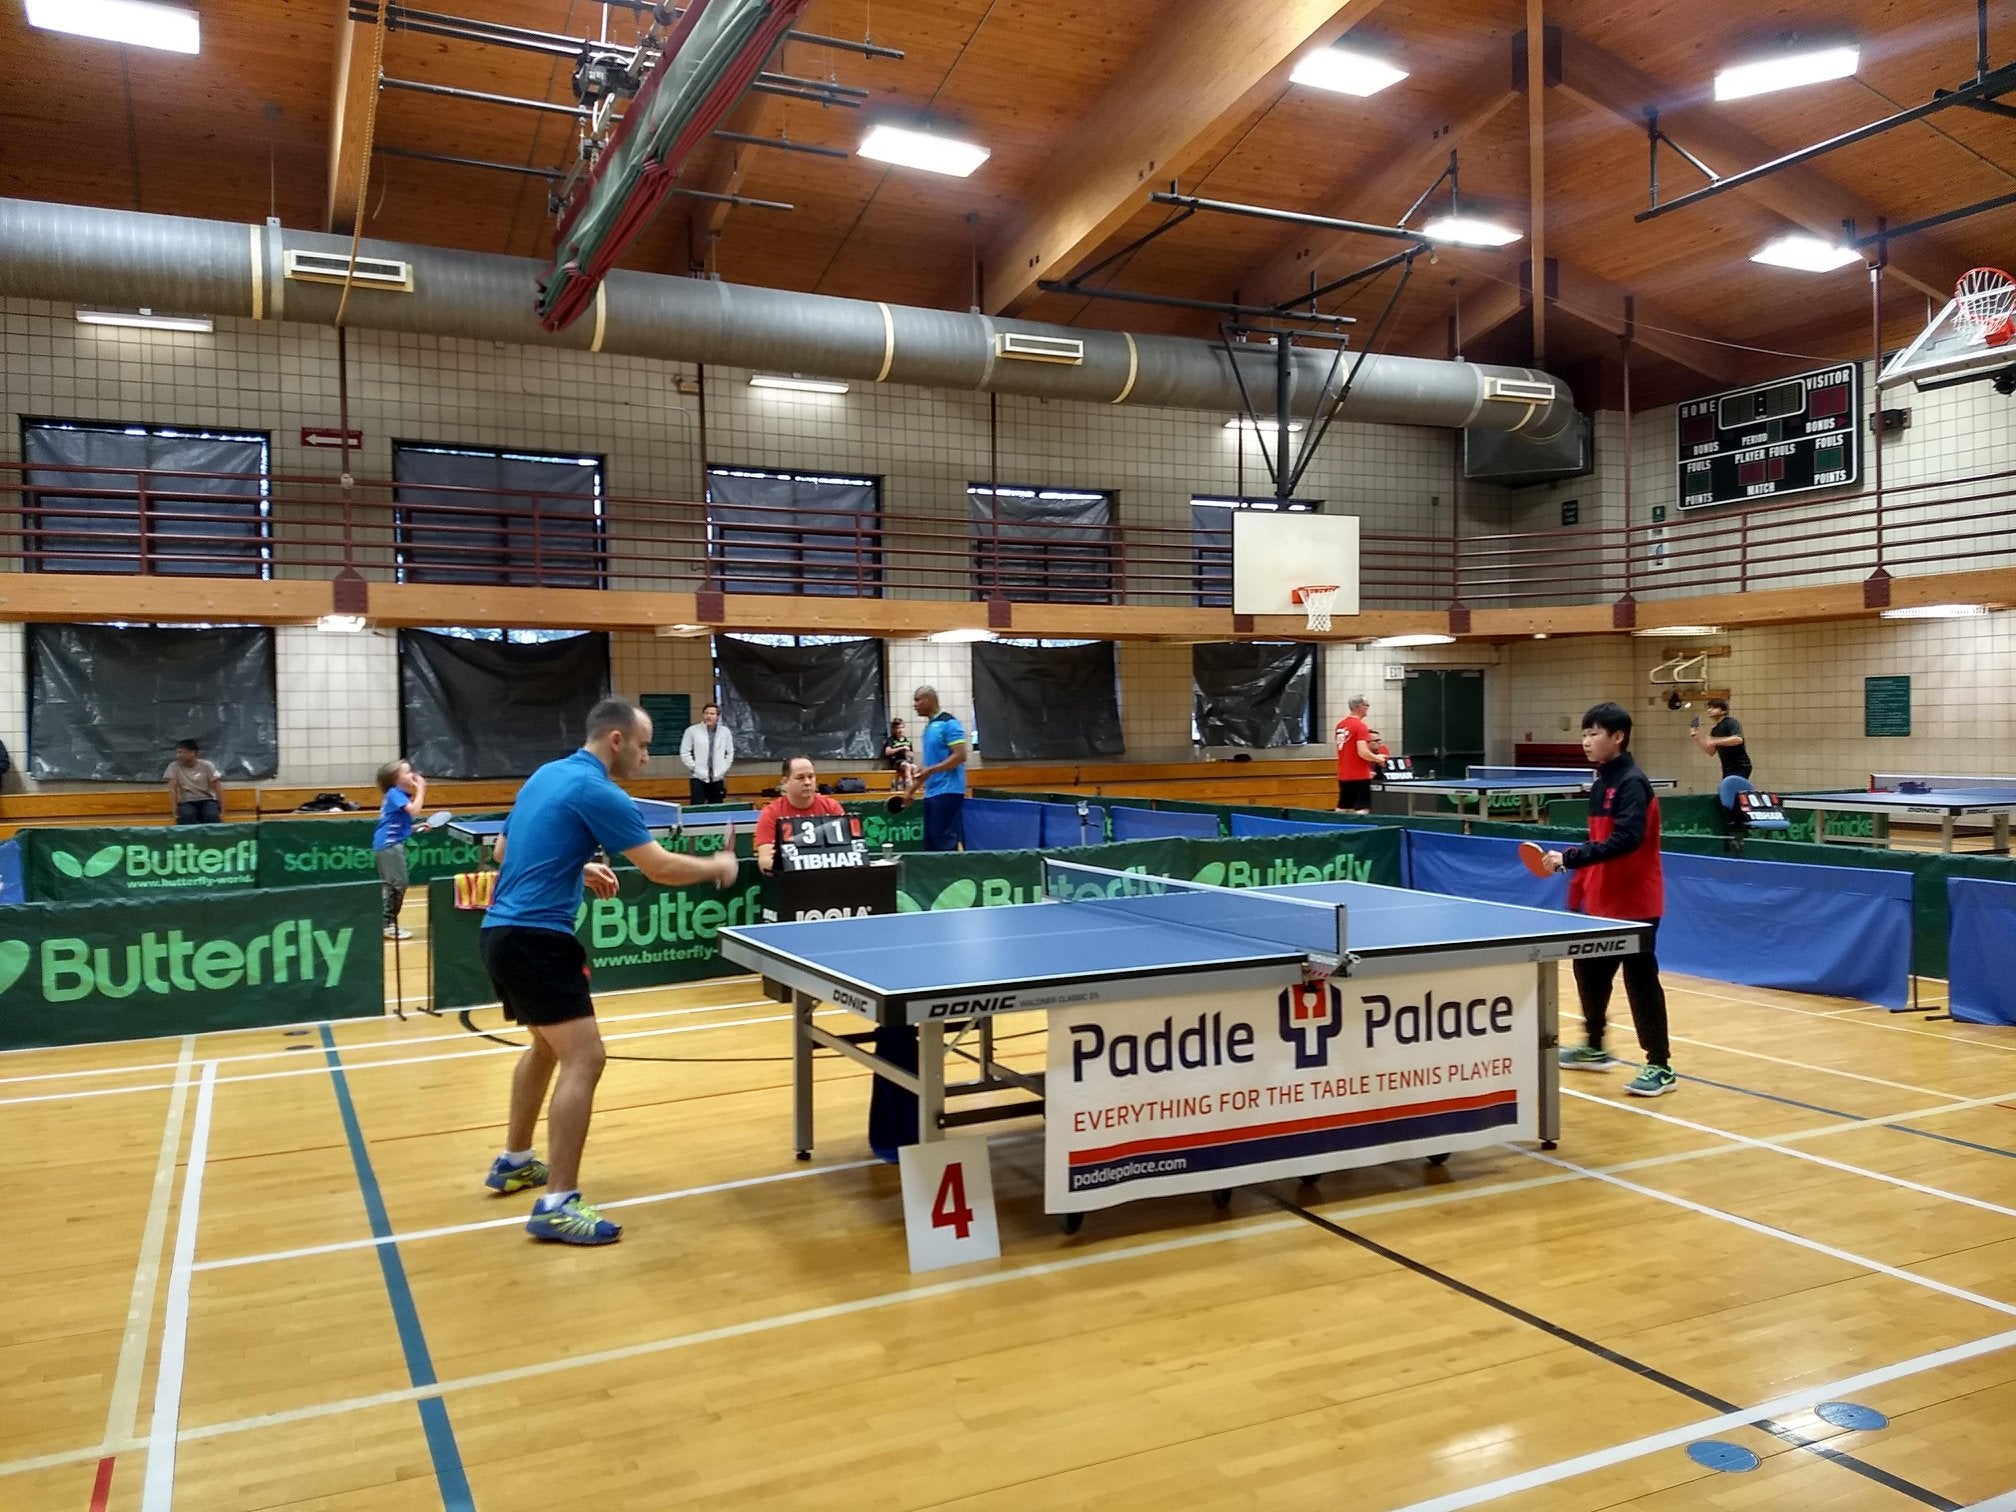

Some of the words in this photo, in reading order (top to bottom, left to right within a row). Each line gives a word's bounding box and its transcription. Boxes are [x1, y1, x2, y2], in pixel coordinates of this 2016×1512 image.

[1806, 369, 1850, 391] VISITOR
[1682, 401, 1717, 418] HOME
[1806, 417, 1836, 433] BONUS
[1693, 442, 1719, 456] BONUS
[1742, 432, 1768, 446] PERIOD
[1815, 434, 1844, 449] FOULS
[1735, 449, 1766, 465] PLAYER
[1769, 443, 1796, 458] FOULS
[1687, 460, 1712, 473] FOULS
[1814, 470, 1847, 485] POINTS
[1685, 493, 1713, 506] POINTS
[1747, 482, 1775, 496] MATCH
[781, 822, 793, 842] 2
[801, 821, 815, 844] 3
[832, 821, 844, 843] 1
[126, 840, 257, 876] Butterfl
[789, 851, 864, 871] TIBHAR
[127, 875, 255, 889] www.butterfly-world.
[1228, 853, 1373, 889] Butterfly
[592, 885, 762, 949] Butterf
[593, 945, 719, 968] www.butterfly-
[1567, 939, 1627, 955] DONIC
[41, 918, 354, 1003] Butterfly
[833, 988, 868, 1013] DONIC
[929, 995, 1017, 1018] DONIC
[1069, 1012, 1255, 1083] Paddle
[1360, 990, 1514, 1049] Palace
[1074, 1096, 1213, 1133] EVERYTHING
[1219, 1090, 1260, 1114] FOR
[1267, 1083, 1305, 1105] THE
[1311, 1076, 1371, 1101] TABLE
[1376, 1066, 1443, 1092] TENNIS
[1448, 1056, 1514, 1084] PLAYER
[1073, 1155, 1187, 1190] paddlepalace.com
[930, 1162, 974, 1240] 4
